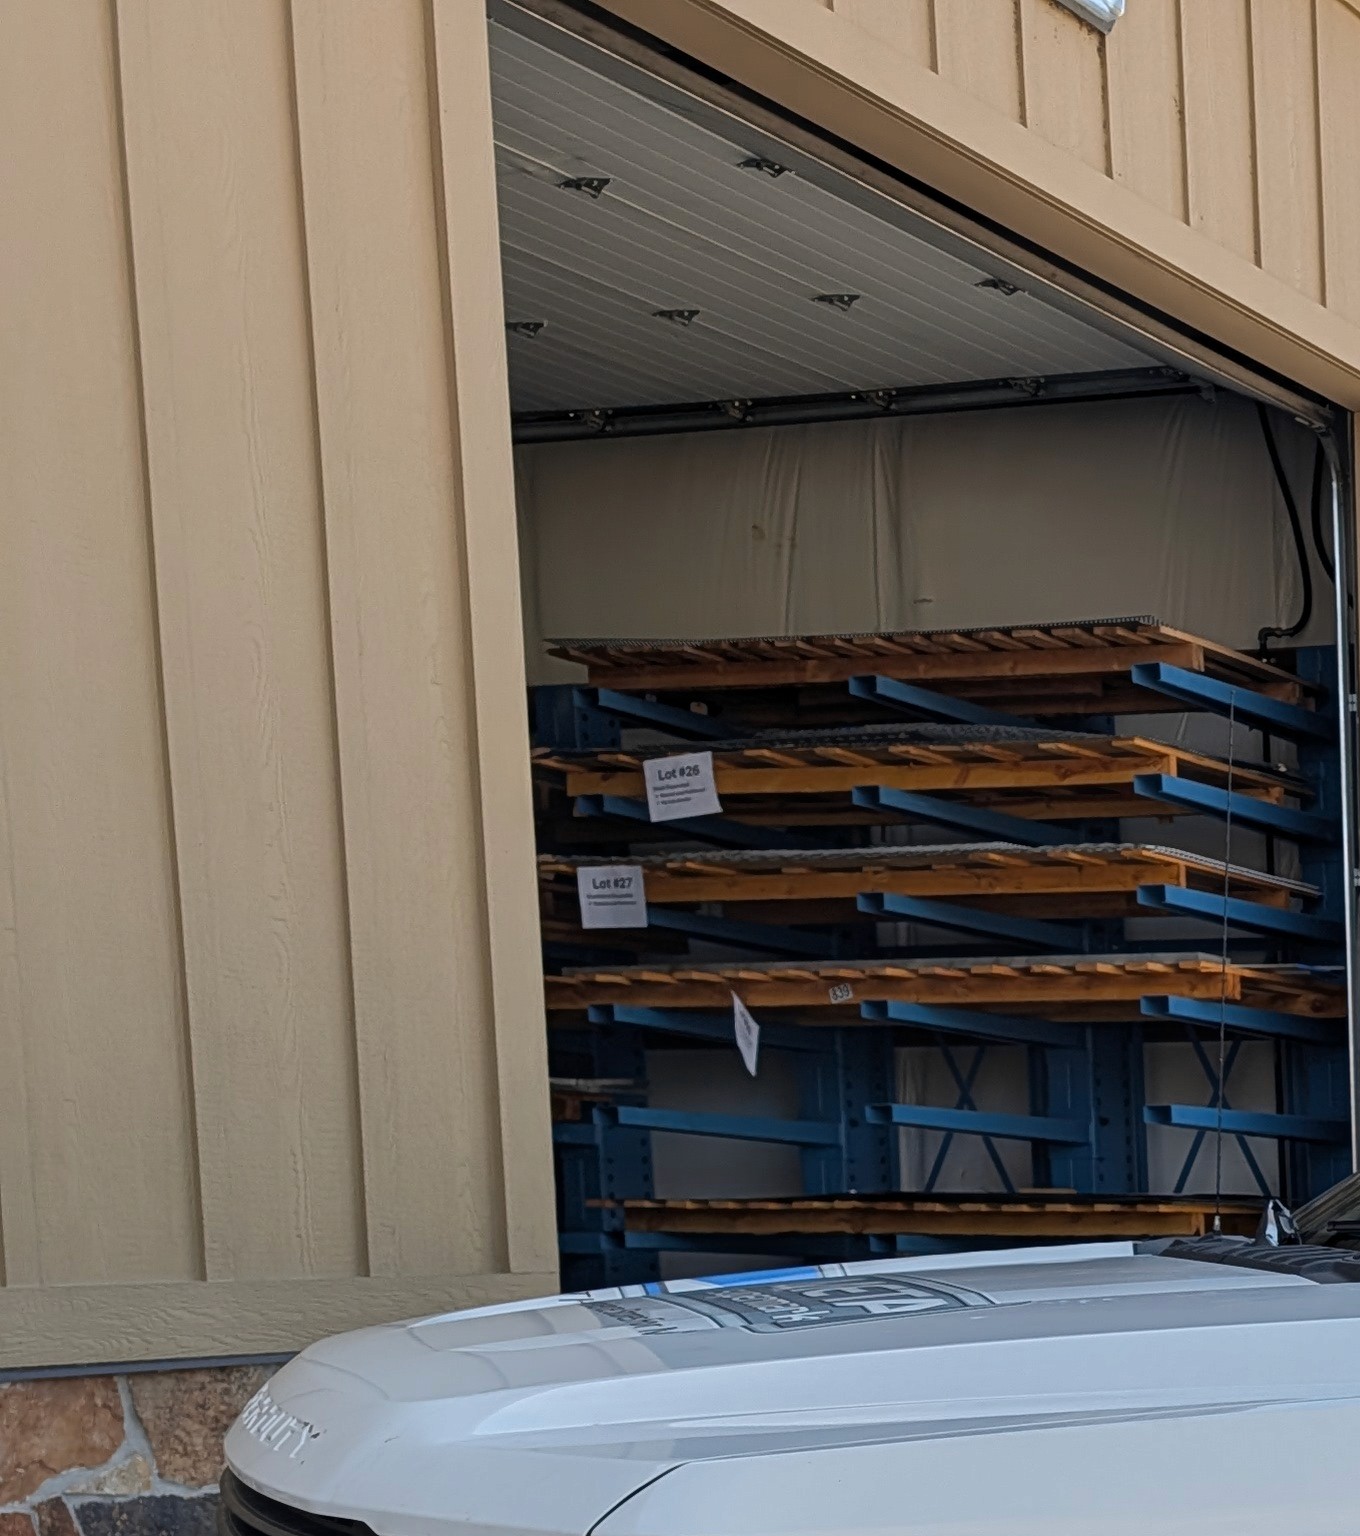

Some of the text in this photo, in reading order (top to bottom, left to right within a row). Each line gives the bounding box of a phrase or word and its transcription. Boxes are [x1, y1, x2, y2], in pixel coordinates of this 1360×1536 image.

[657, 768, 677, 781] Lot
[592, 877, 633, 890] Lot #27
